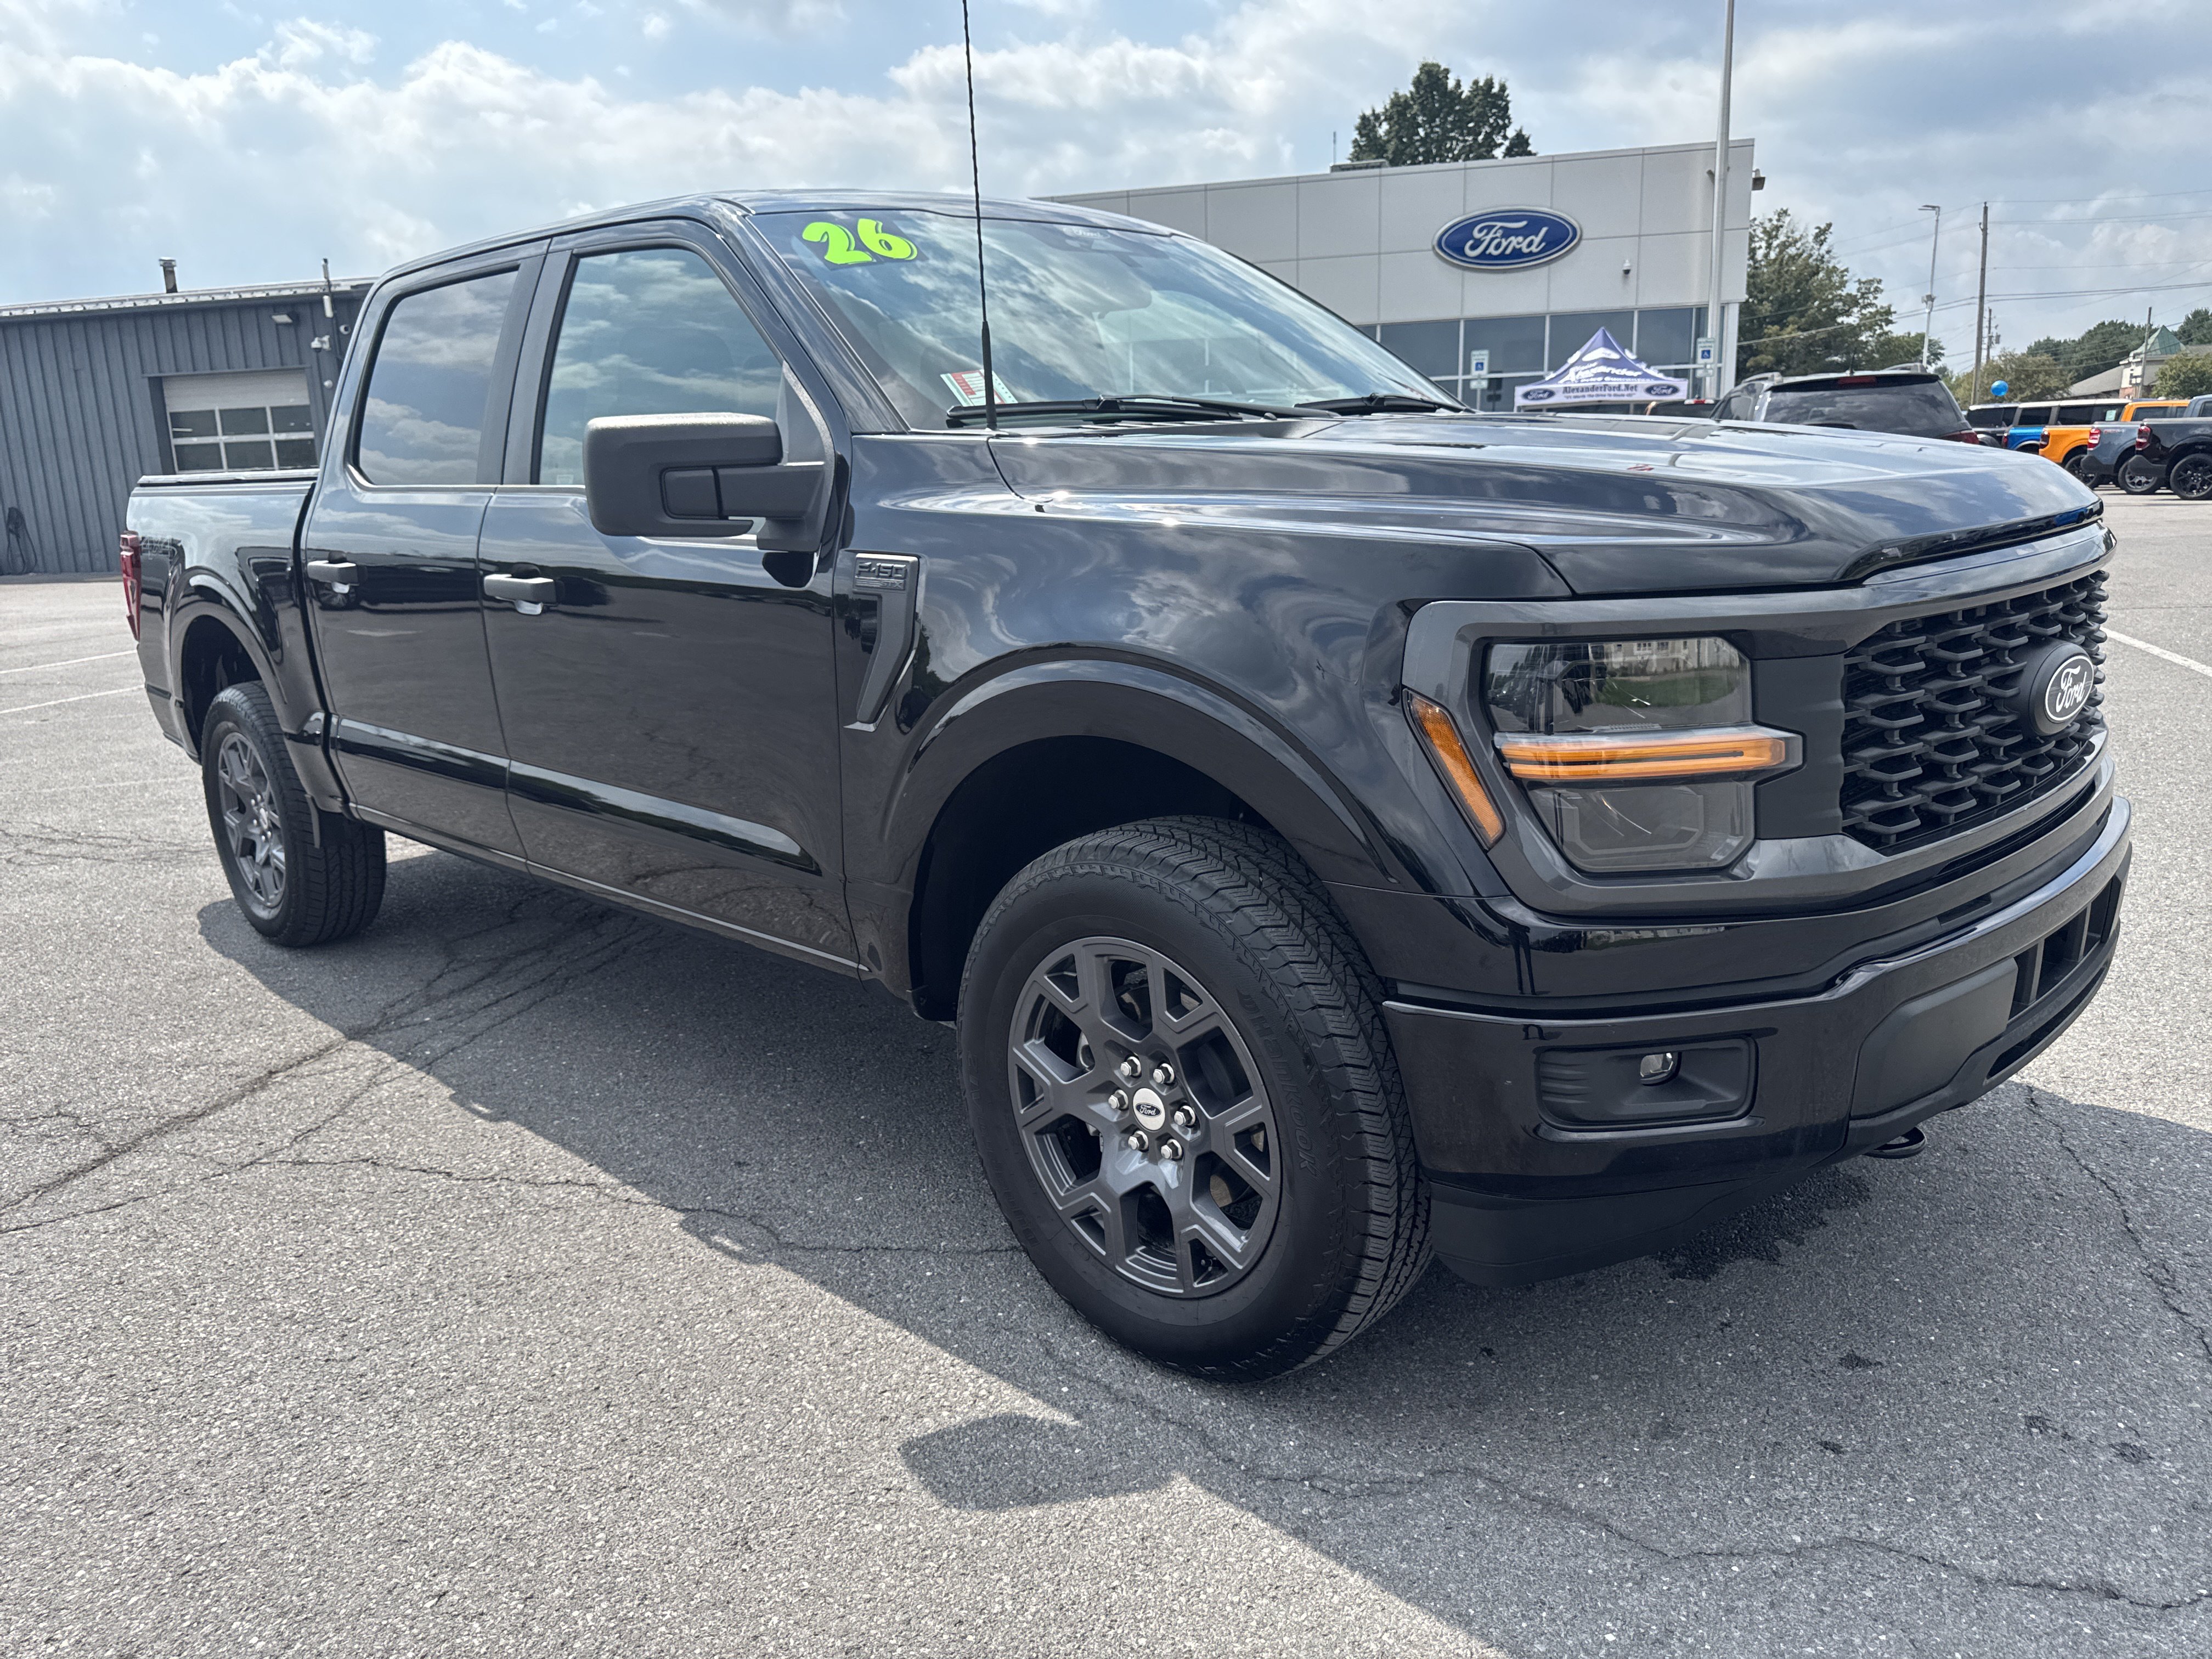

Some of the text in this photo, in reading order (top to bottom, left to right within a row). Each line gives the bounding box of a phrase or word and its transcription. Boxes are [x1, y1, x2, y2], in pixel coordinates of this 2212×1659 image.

[802, 218, 917, 264] 26
[1464, 221, 1549, 257] Ford
[1562, 384, 1638, 394] AlexanderFord.Net
[857, 562, 907, 578] F-150
[879, 580, 904, 589] STX
[2056, 665, 2087, 713] Ford
[1139, 1104, 1156, 1115] Ford
